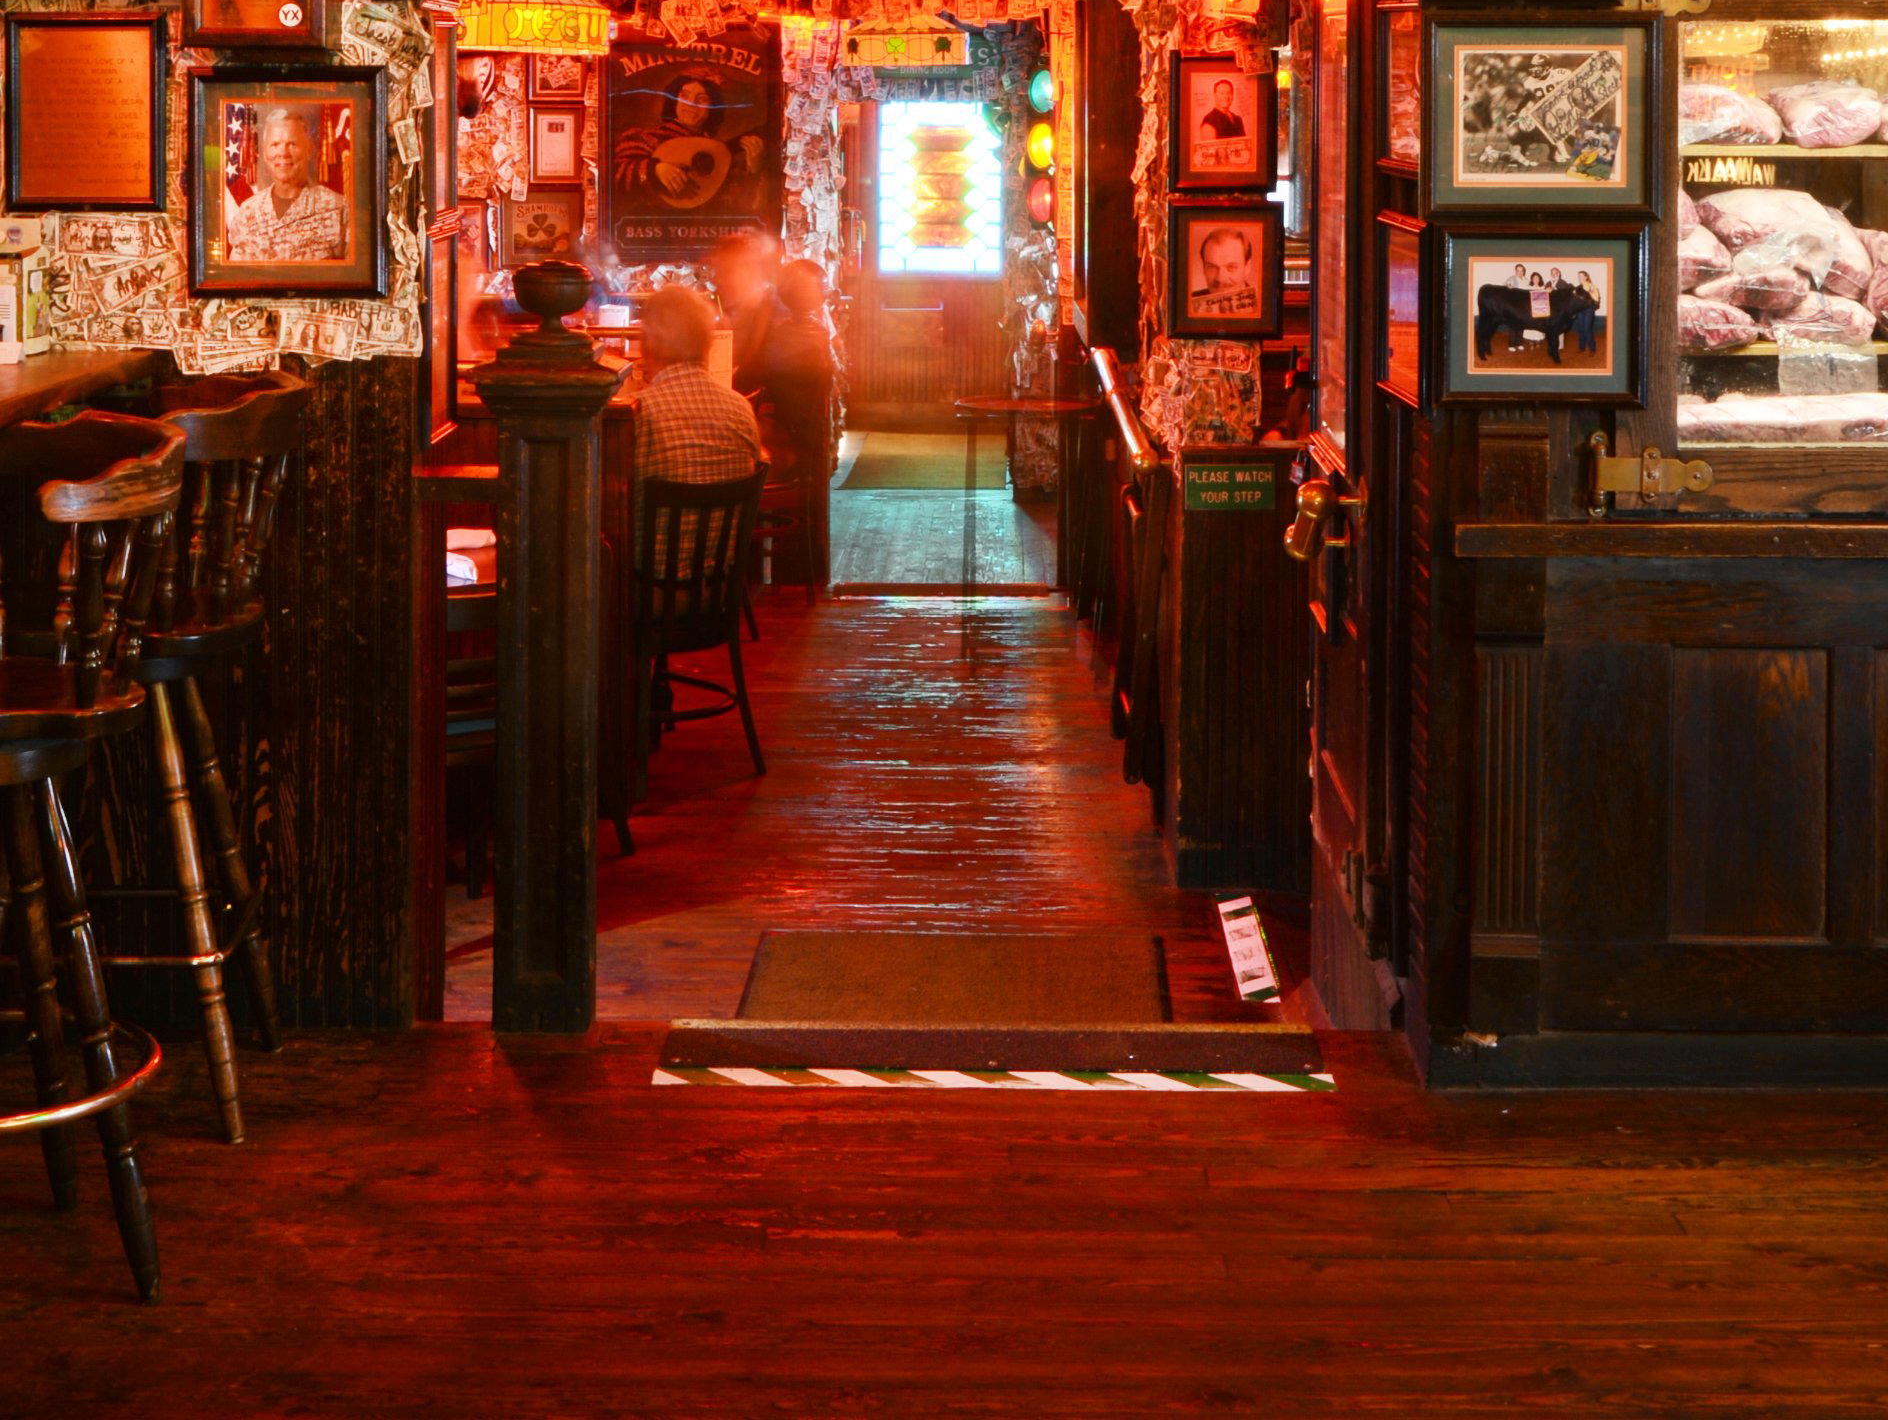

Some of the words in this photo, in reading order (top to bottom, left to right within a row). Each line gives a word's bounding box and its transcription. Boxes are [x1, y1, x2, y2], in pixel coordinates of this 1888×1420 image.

[282, 10, 300, 20] YX
[625, 226, 662, 238] BASS
[1188, 471, 1230, 483] PLEASE
[1235, 471, 1272, 483] WATCH
[1200, 491, 1229, 503] YOUR
[1233, 491, 1262, 503] STEP
